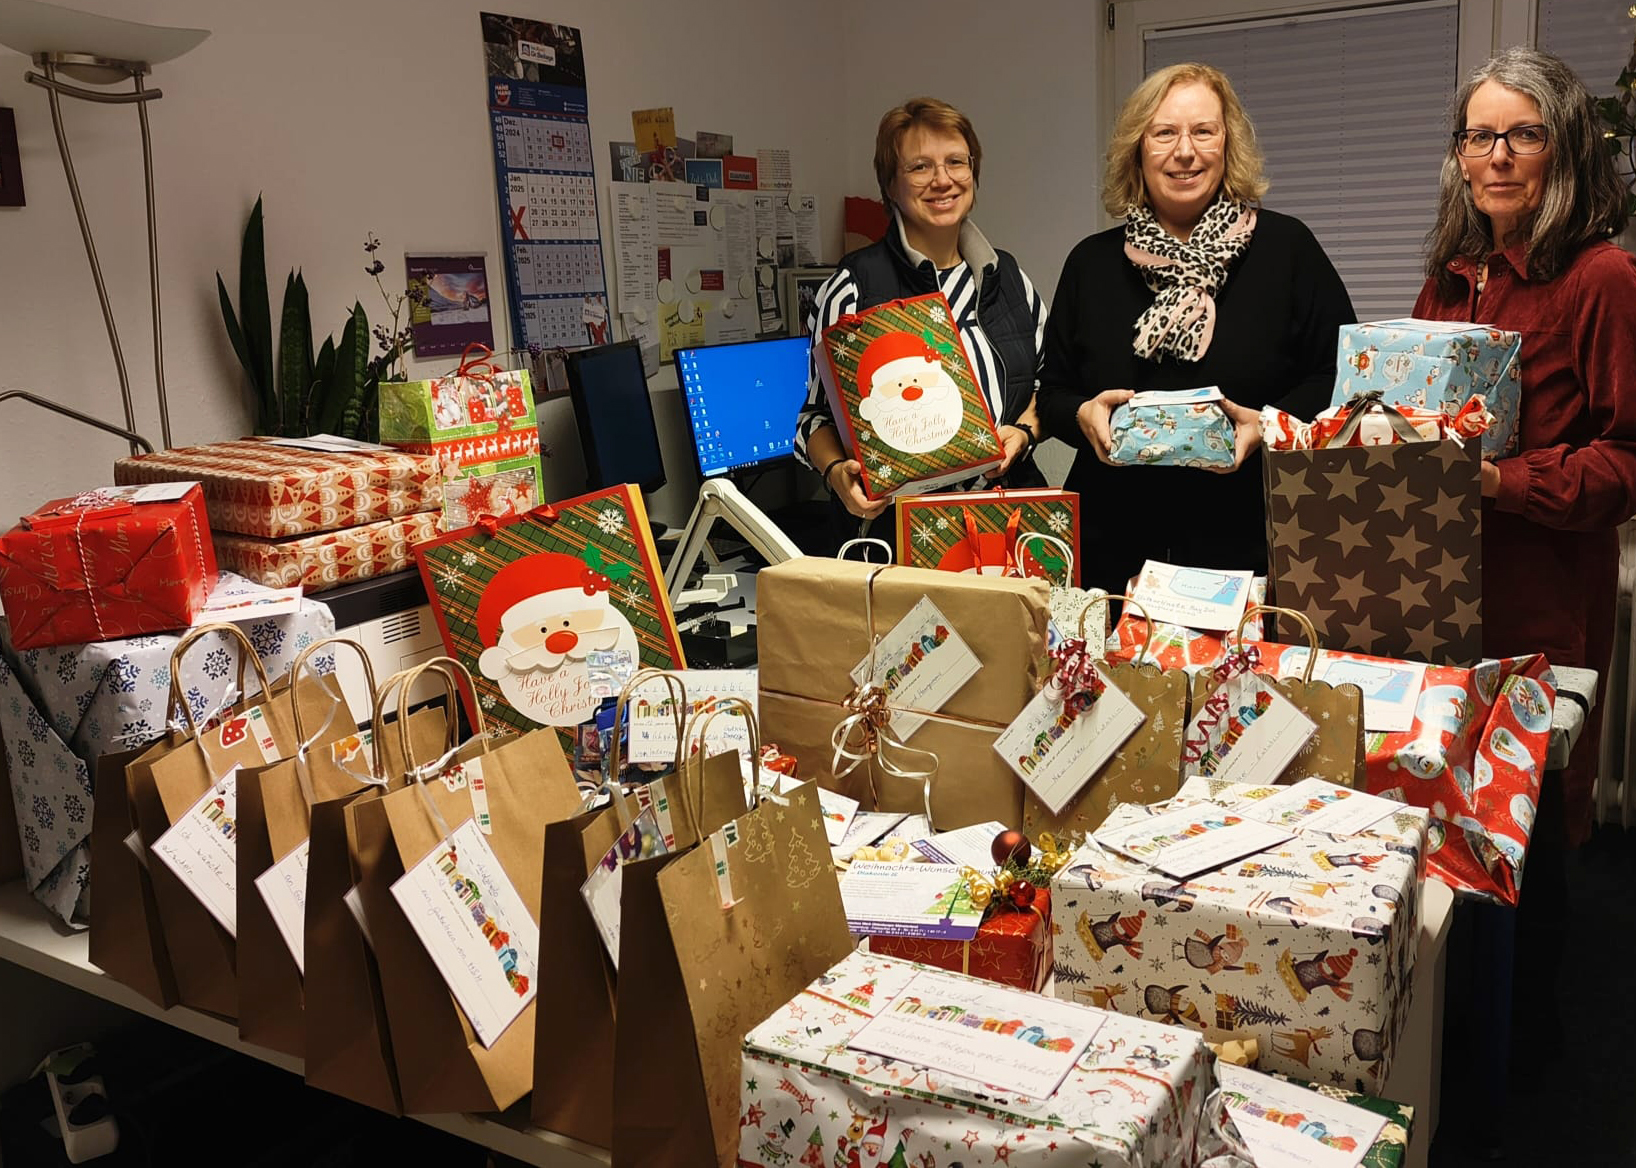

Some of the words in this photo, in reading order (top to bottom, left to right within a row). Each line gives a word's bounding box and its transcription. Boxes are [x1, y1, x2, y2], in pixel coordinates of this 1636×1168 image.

[883, 414, 908, 428] Have
[890, 425, 919, 440] Holly
[920, 416, 946, 430] Jolly
[904, 427, 954, 446] Christmas
[516, 673, 555, 690] Have
[560, 670, 570, 678] a
[526, 684, 569, 706] Holly
